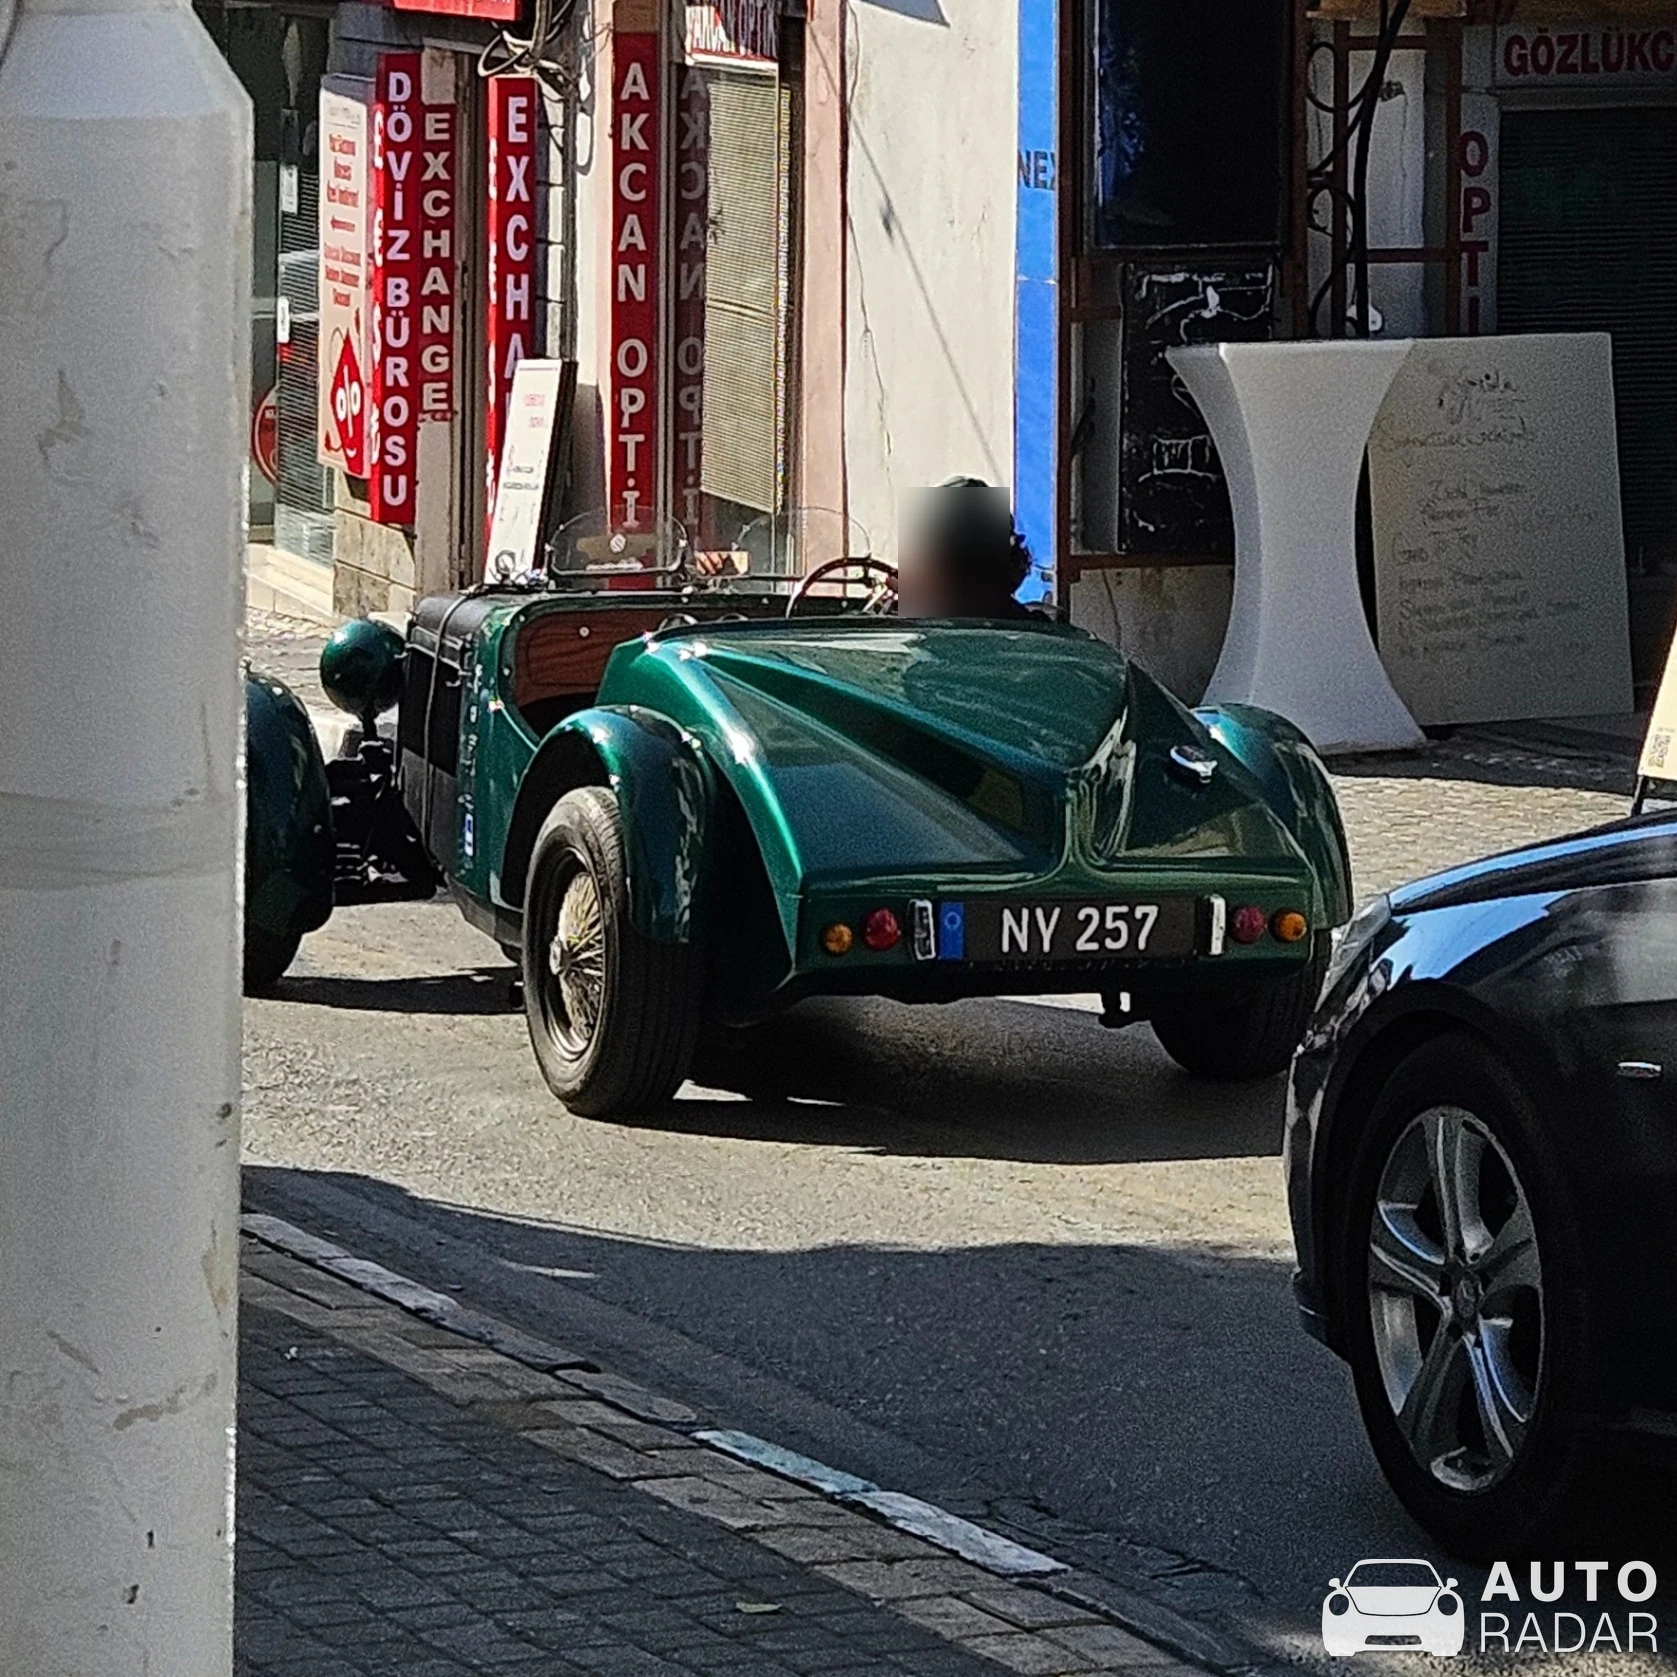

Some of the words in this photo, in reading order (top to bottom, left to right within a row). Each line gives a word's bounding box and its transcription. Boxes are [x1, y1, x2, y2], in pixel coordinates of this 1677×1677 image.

[386, 72, 413, 261] DÖVİZ
[421, 113, 457, 411] EXCHANGE
[503, 96, 530, 418] EXCHA
[618, 62, 650, 303] AKCAN
[383, 277, 410, 507] BÜROSU
[1002, 906, 1061, 953] NY
[1075, 905, 1159, 951] 257
